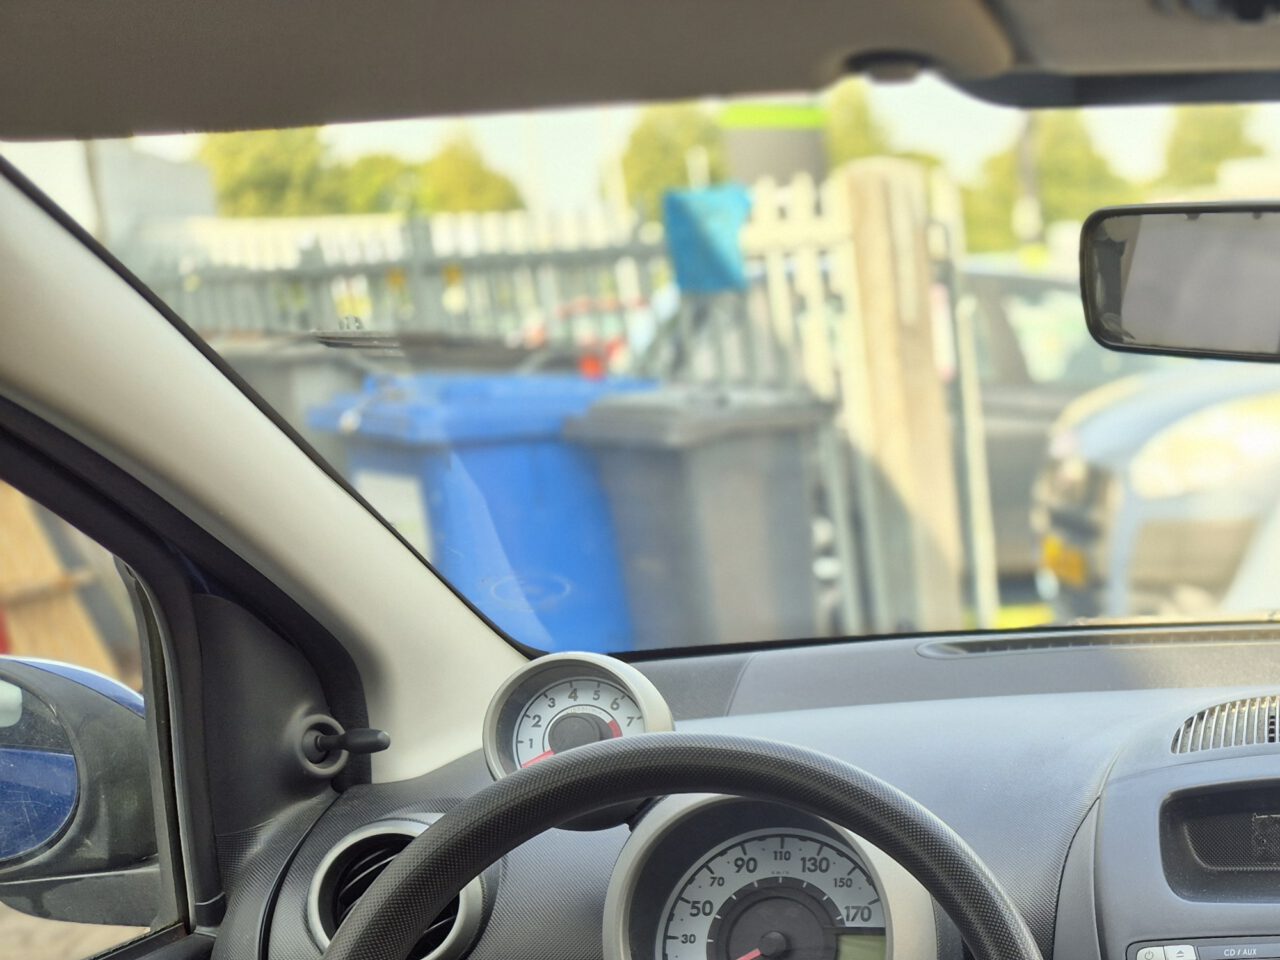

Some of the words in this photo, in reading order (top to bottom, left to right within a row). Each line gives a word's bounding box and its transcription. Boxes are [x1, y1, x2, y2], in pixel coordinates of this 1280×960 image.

[568, 688, 578, 701] 4
[592, 690, 600, 700] 5
[548, 698, 556, 708] 3
[610, 698, 620, 711] 6
[531, 714, 542, 728] 2
[627, 716, 635, 727] 7
[528, 738, 534, 749] 1
[773, 850, 791, 861] 110
[734, 857, 758, 873] 90
[800, 857, 830, 873] 130
[709, 877, 725, 887] 70
[833, 878, 853, 888] 150
[689, 900, 713, 917] 50
[844, 906, 872, 922] 170
[680, 934, 696, 944] 30
[1223, 948, 1235, 957] CD
[1243, 948, 1257, 956] AUX
